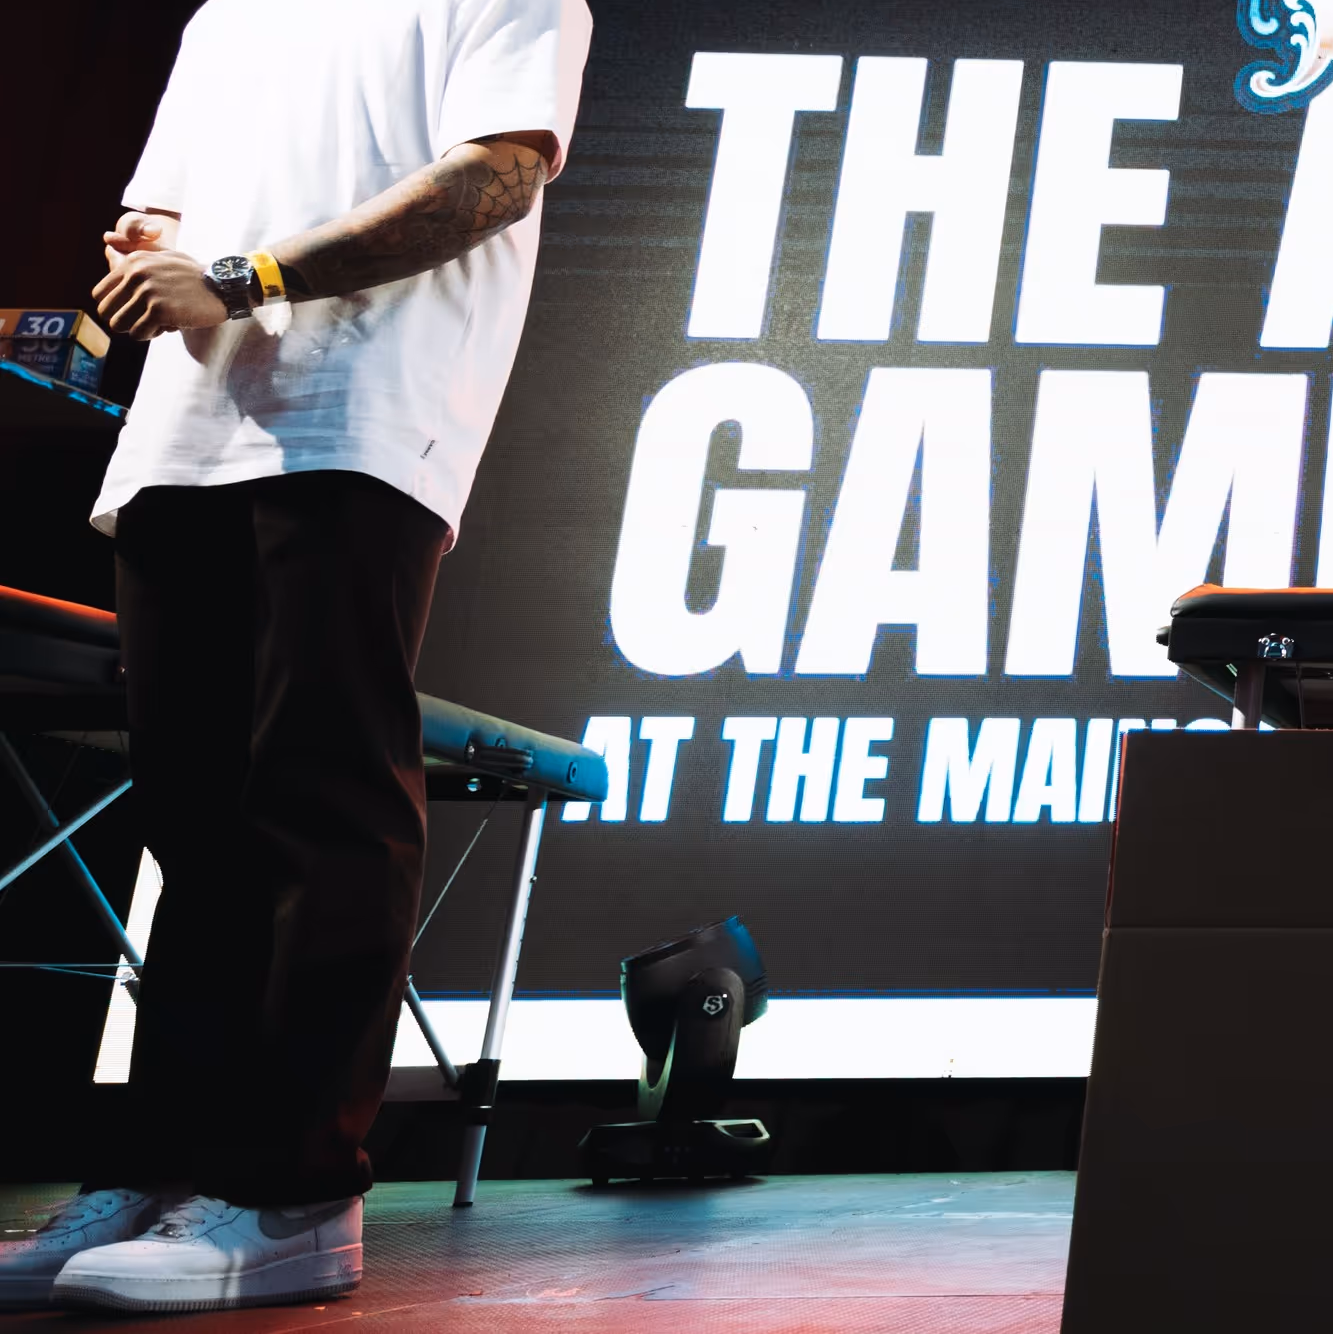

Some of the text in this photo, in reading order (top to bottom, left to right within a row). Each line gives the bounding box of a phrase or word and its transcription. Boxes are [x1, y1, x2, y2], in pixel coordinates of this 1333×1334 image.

[685, 52, 1184, 345] THE
[21, 316, 65, 335] 30
[561, 716, 1172, 822] AT THE MAI
